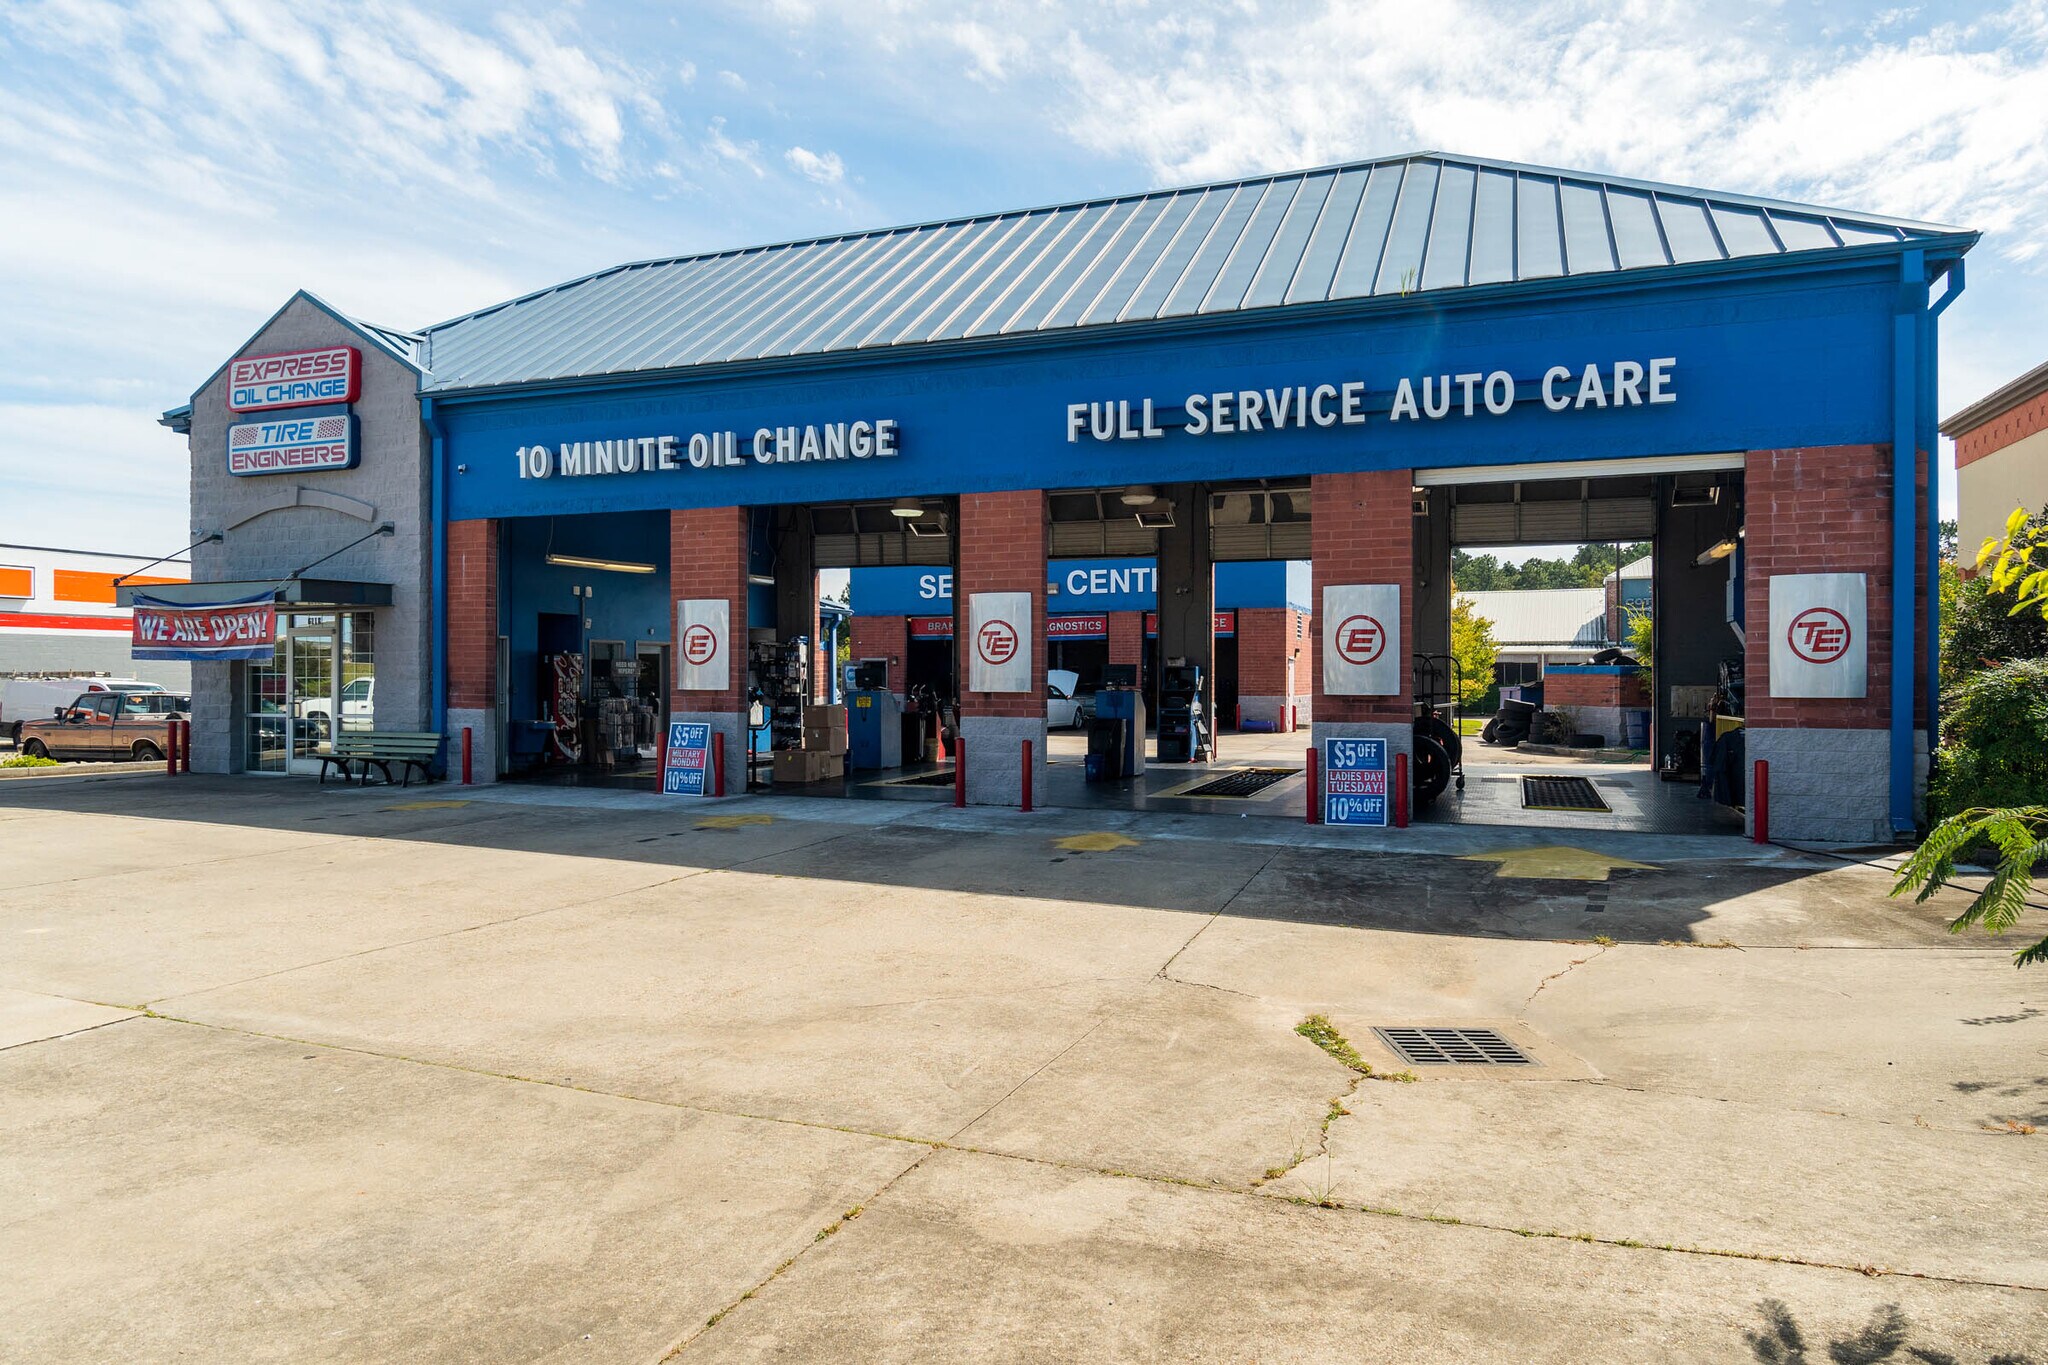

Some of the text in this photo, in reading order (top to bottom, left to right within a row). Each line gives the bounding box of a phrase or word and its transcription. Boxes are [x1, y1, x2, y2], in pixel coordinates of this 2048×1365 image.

[234, 351, 348, 382] EXPRESS
[234, 379, 346, 405] OIL CHANGE
[1067, 357, 1678, 443] FULL SERVICE AUTO CARE
[261, 421, 315, 444] TIRE
[232, 444, 346, 470] ENGINEERS
[516, 419, 899, 479] 10 MINUTE OIL CHANGE
[138, 611, 268, 641] WE ARE OPEN!
[1047, 621, 1102, 632] GNOSTICS
[674, 725, 704, 747] $5 OFF
[671, 757, 700, 767] MONDAY
[672, 749, 701, 758] MILITARY
[1334, 741, 1377, 768] $5 OFF
[667, 771, 688, 791] 10%
[688, 772, 702, 784] OFF
[1330, 771, 1383, 782] LADIES DAY
[1330, 781, 1383, 793] TUESDAY!
[1330, 797, 1382, 820] 10% OFF
